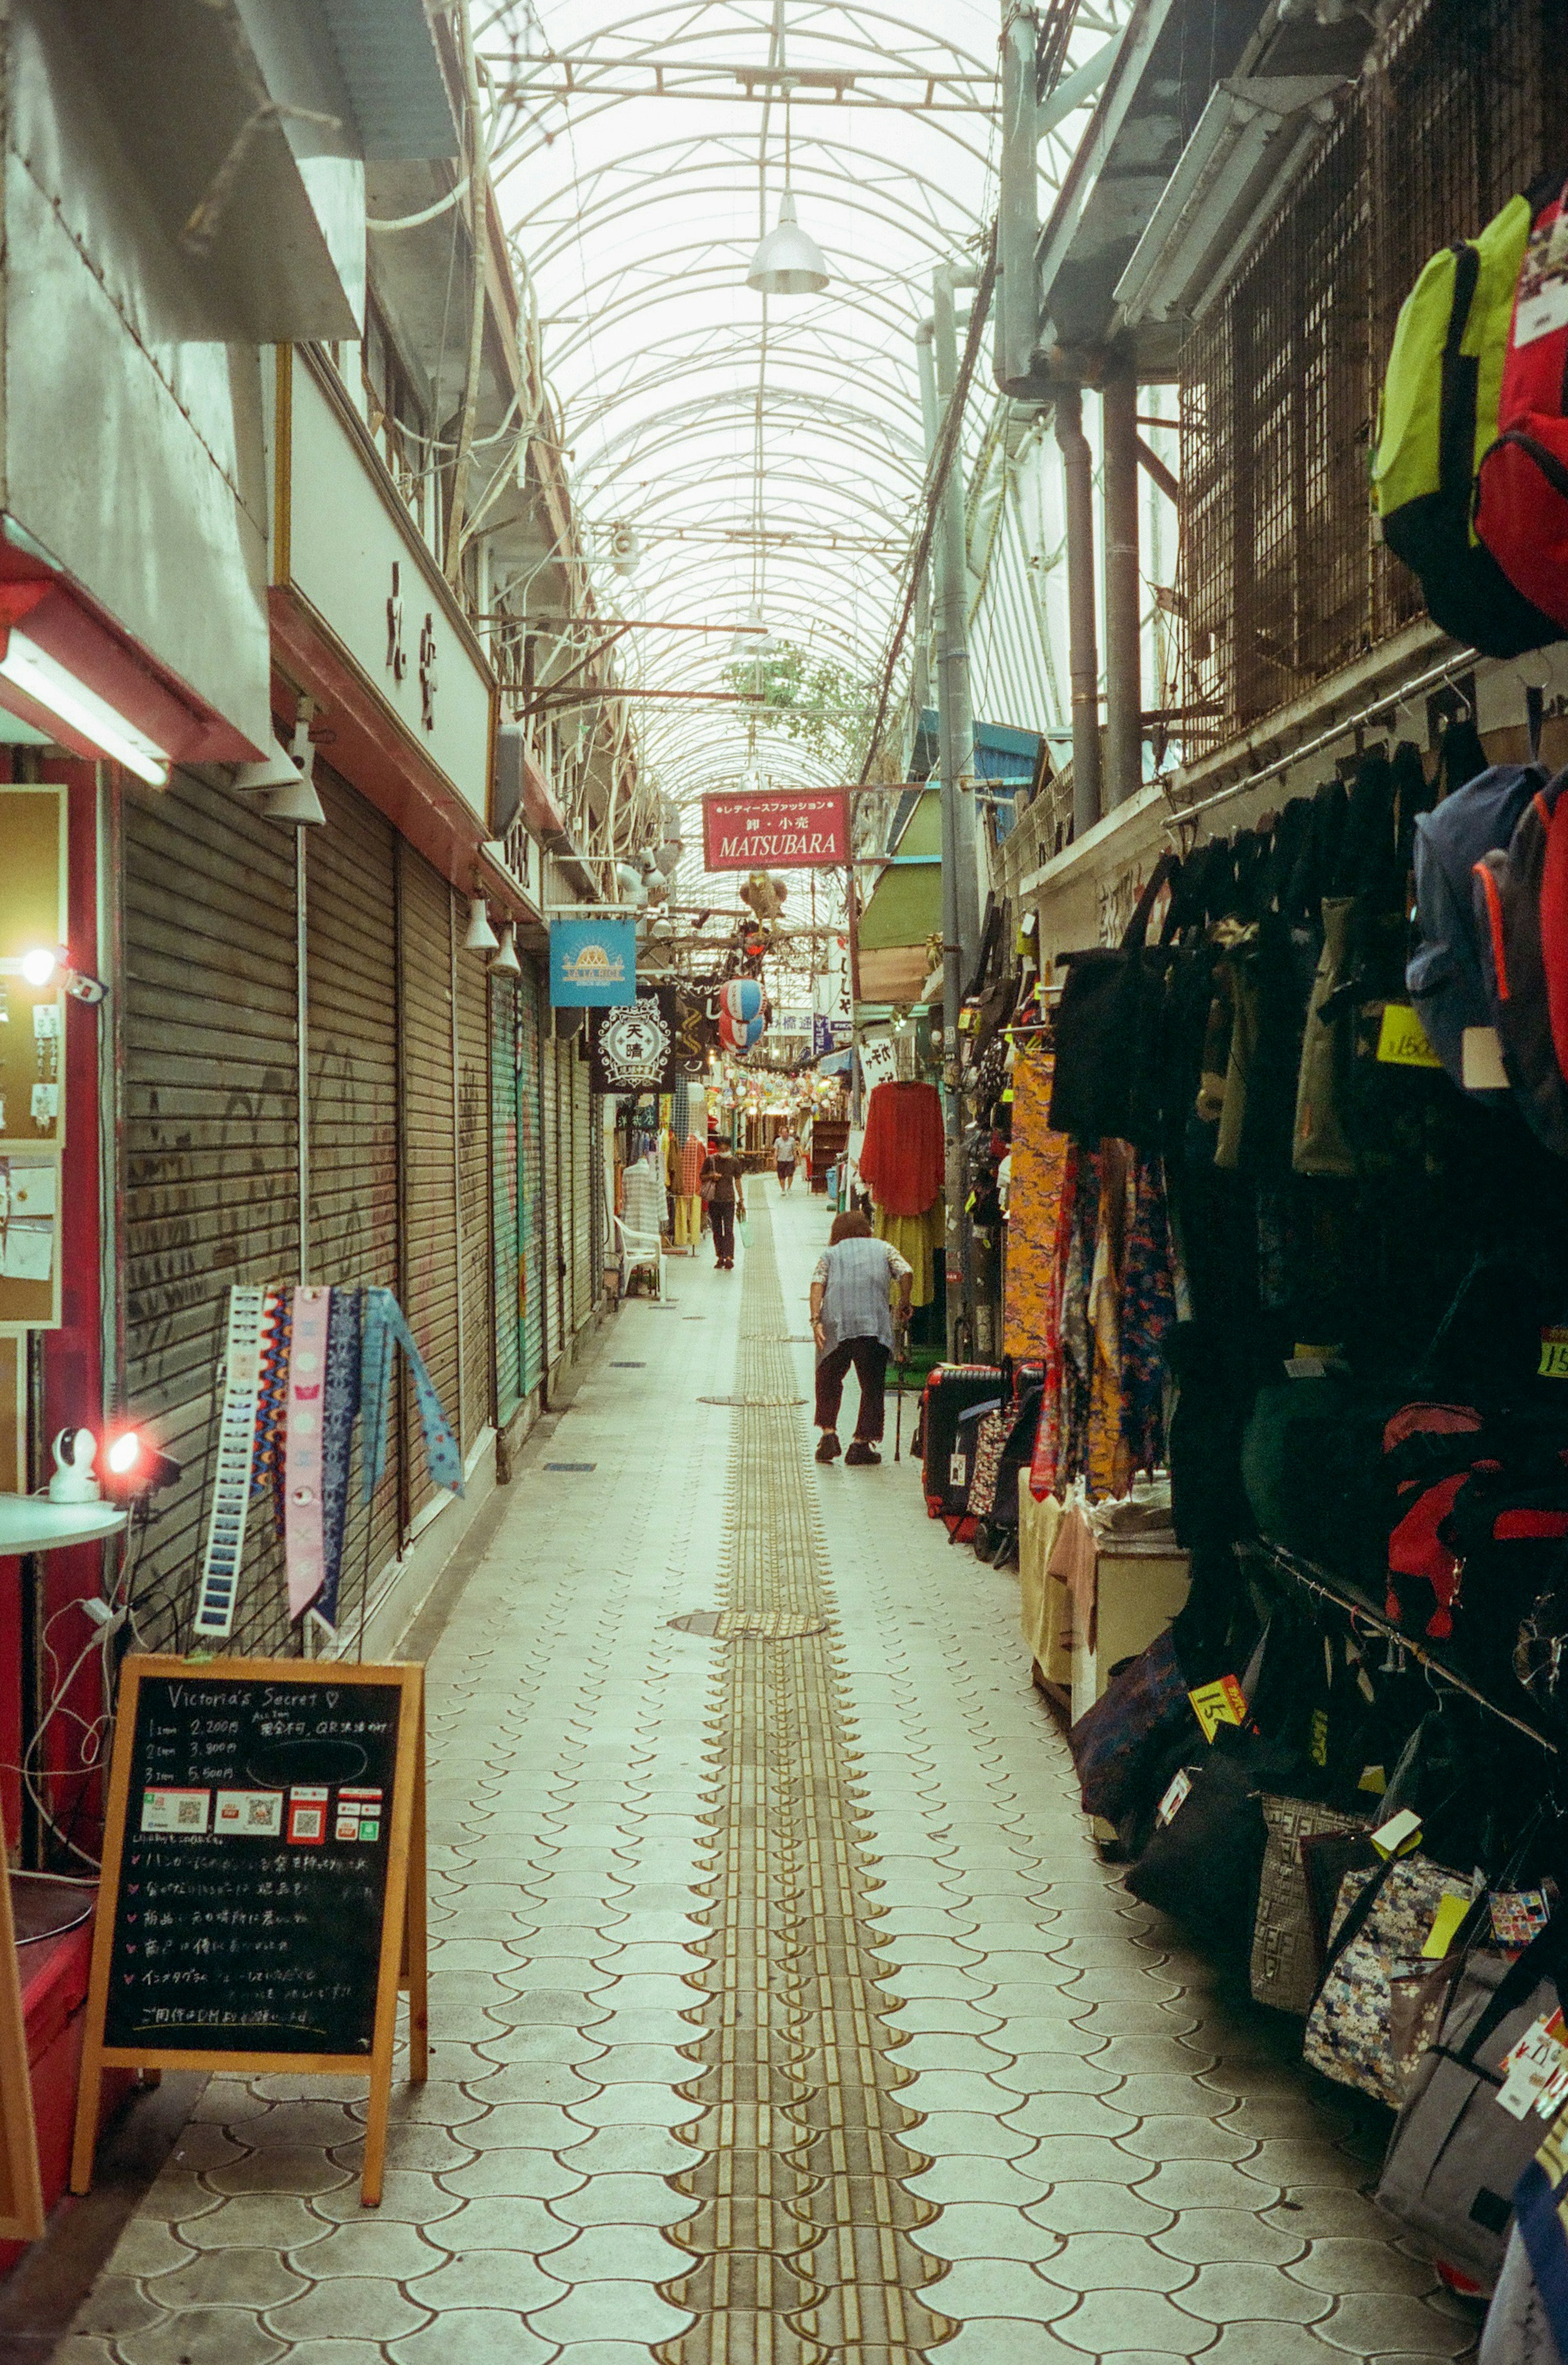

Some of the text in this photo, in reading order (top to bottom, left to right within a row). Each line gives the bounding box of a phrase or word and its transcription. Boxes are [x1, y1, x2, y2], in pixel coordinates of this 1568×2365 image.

[724, 802, 825, 814] レディースファッション
[719, 833, 835, 858] MATSUBARA
[626, 1023, 644, 1059] 天晴
[168, 1684, 318, 1708] Victoria's Secret
